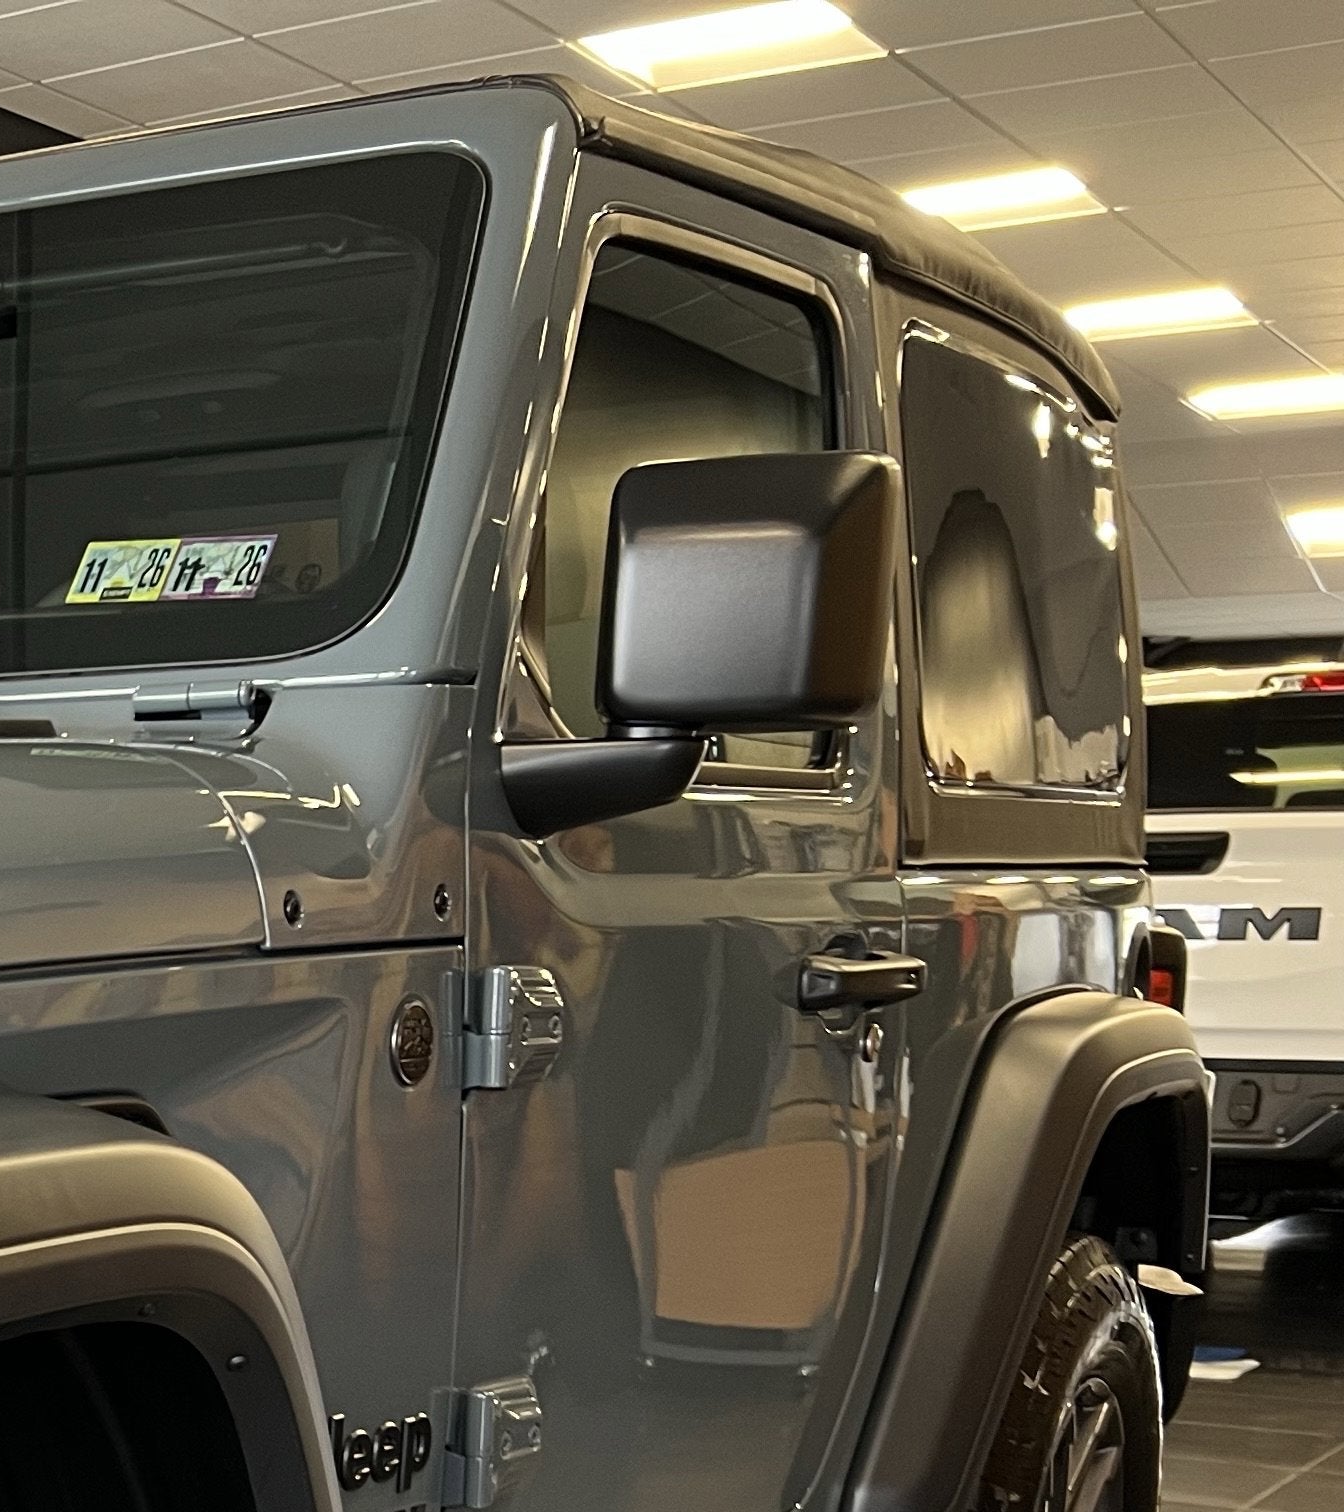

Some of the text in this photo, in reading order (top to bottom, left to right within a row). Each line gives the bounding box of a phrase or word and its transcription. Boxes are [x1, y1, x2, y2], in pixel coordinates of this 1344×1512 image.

[79, 548, 172, 592] 11 26
[233, 545, 268, 586] 26
[1154, 908, 1322, 940] AM
